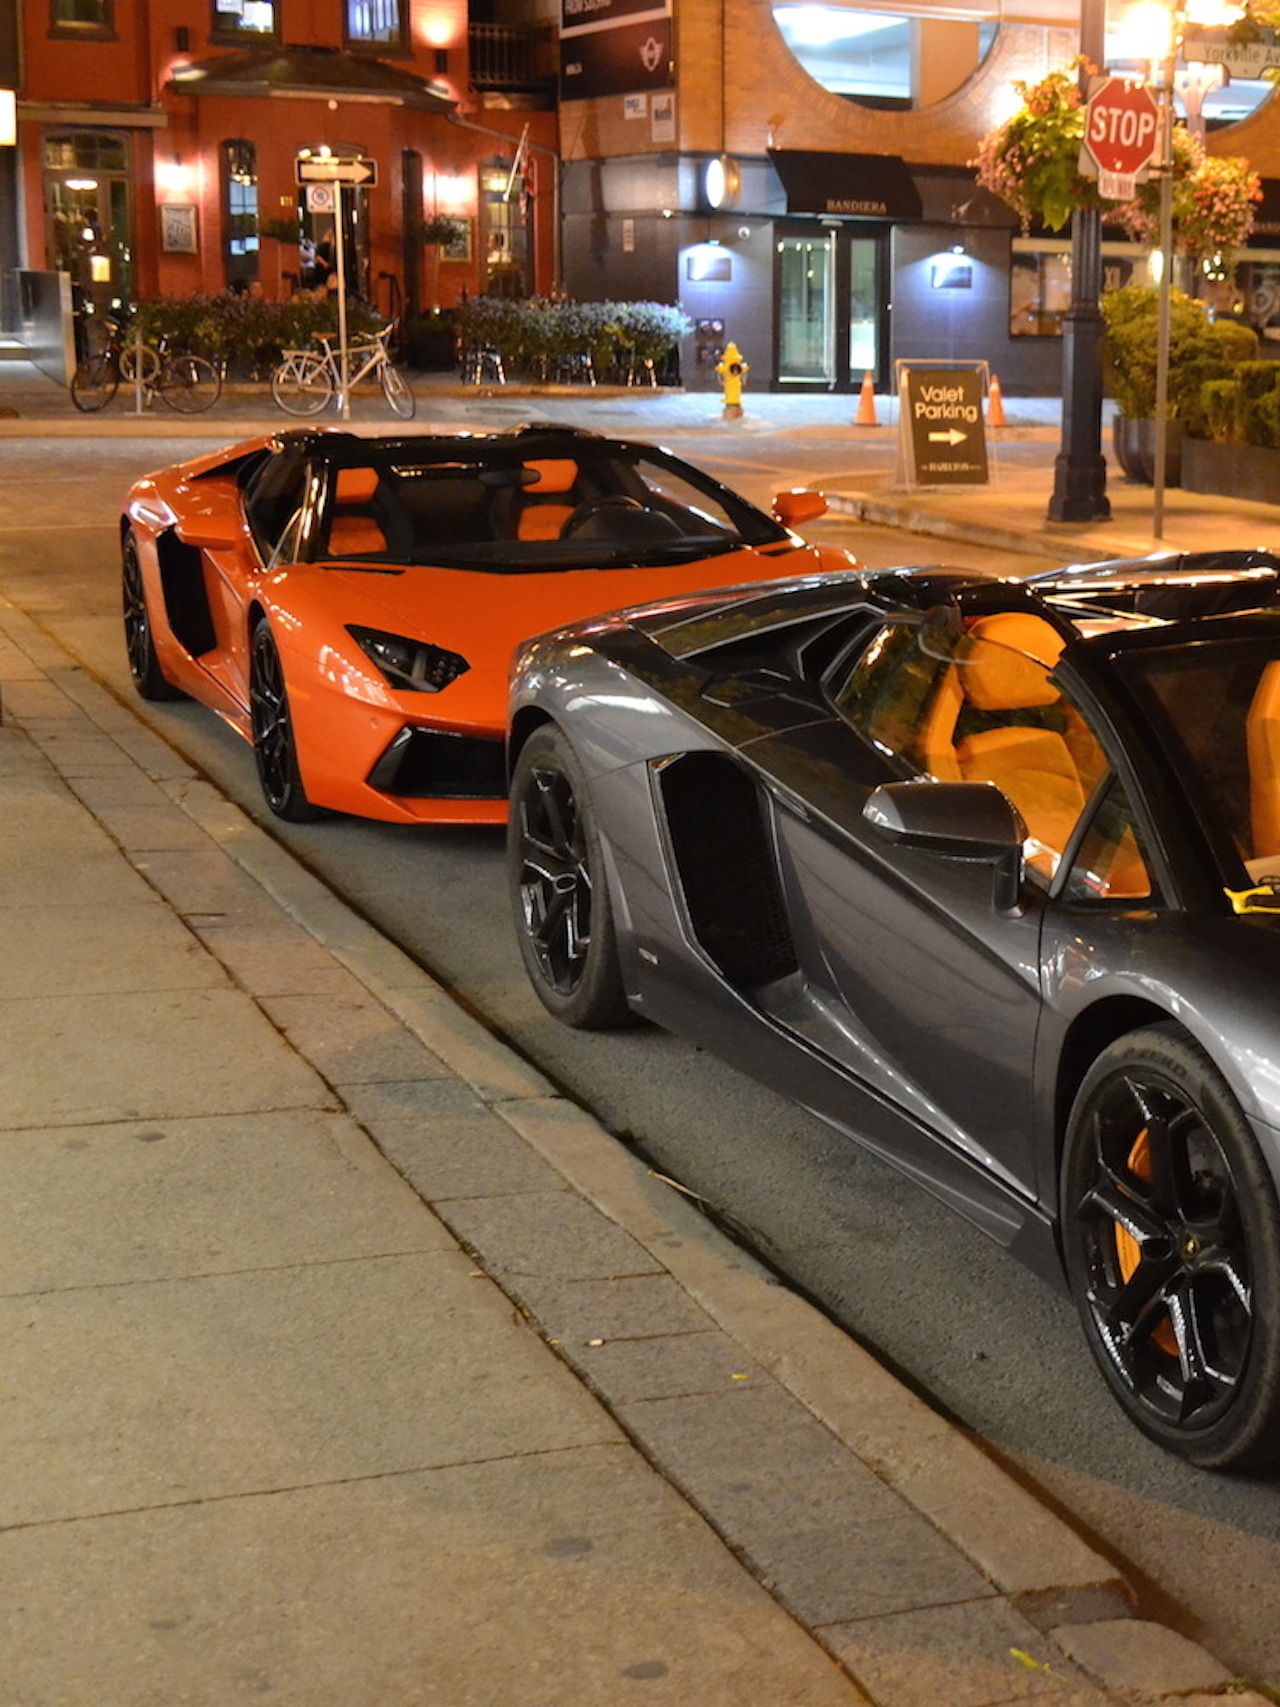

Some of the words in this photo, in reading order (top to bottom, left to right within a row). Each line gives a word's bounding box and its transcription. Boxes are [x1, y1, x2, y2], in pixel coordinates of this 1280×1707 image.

[1204, 44, 1260, 64] Yorkville
[1091, 105, 1155, 148] STOP
[826, 198, 887, 214] BANDIERA
[919, 385, 965, 402] Valet
[914, 402, 978, 423] Parking
